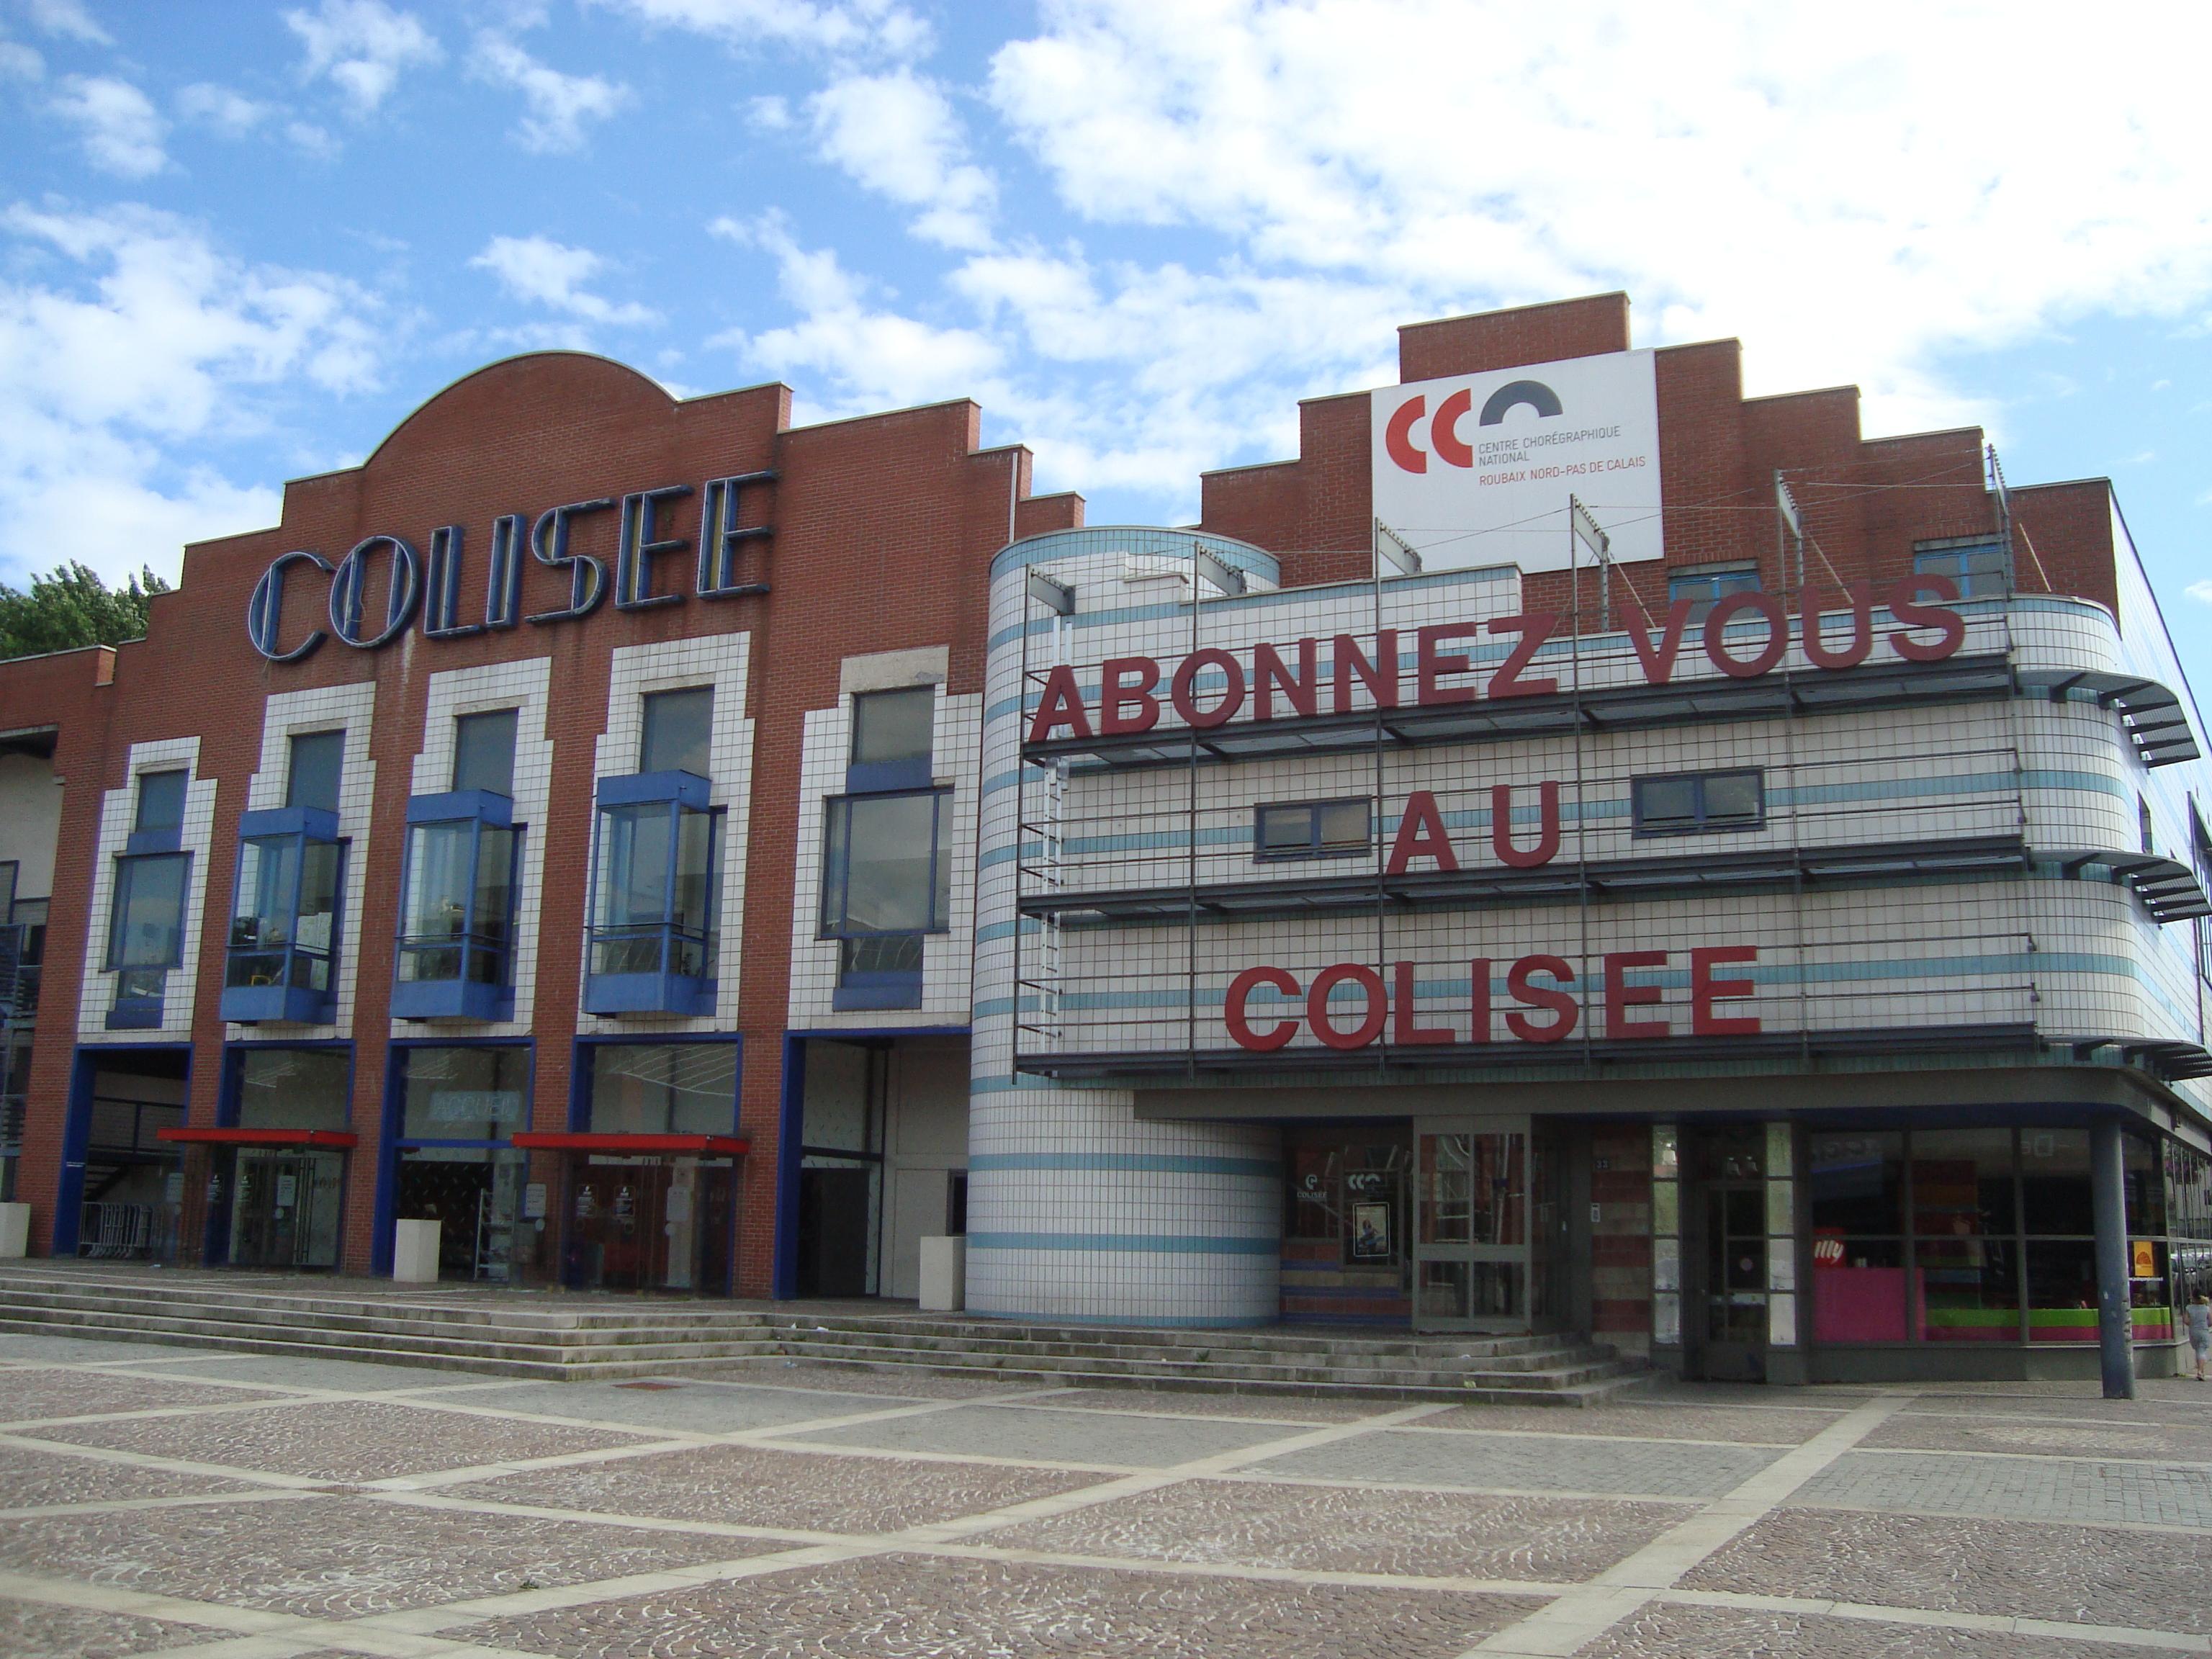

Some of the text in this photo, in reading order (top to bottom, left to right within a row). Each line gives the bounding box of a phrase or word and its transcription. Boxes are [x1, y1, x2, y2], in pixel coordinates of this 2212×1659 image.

[1478, 426, 1622, 454] CENTRE CHORÉGRAPHIQUE
[1478, 451, 1530, 467] NATIONAL
[1479, 456, 1646, 486] ROUBAIX NORD-PAS DE CALAIS
[248, 469, 780, 662] COLISEE
[1029, 574, 1966, 742] ABONNEZ VOUS
[1387, 781, 1560, 874] AU
[1224, 945, 1762, 1051] COLISEE
